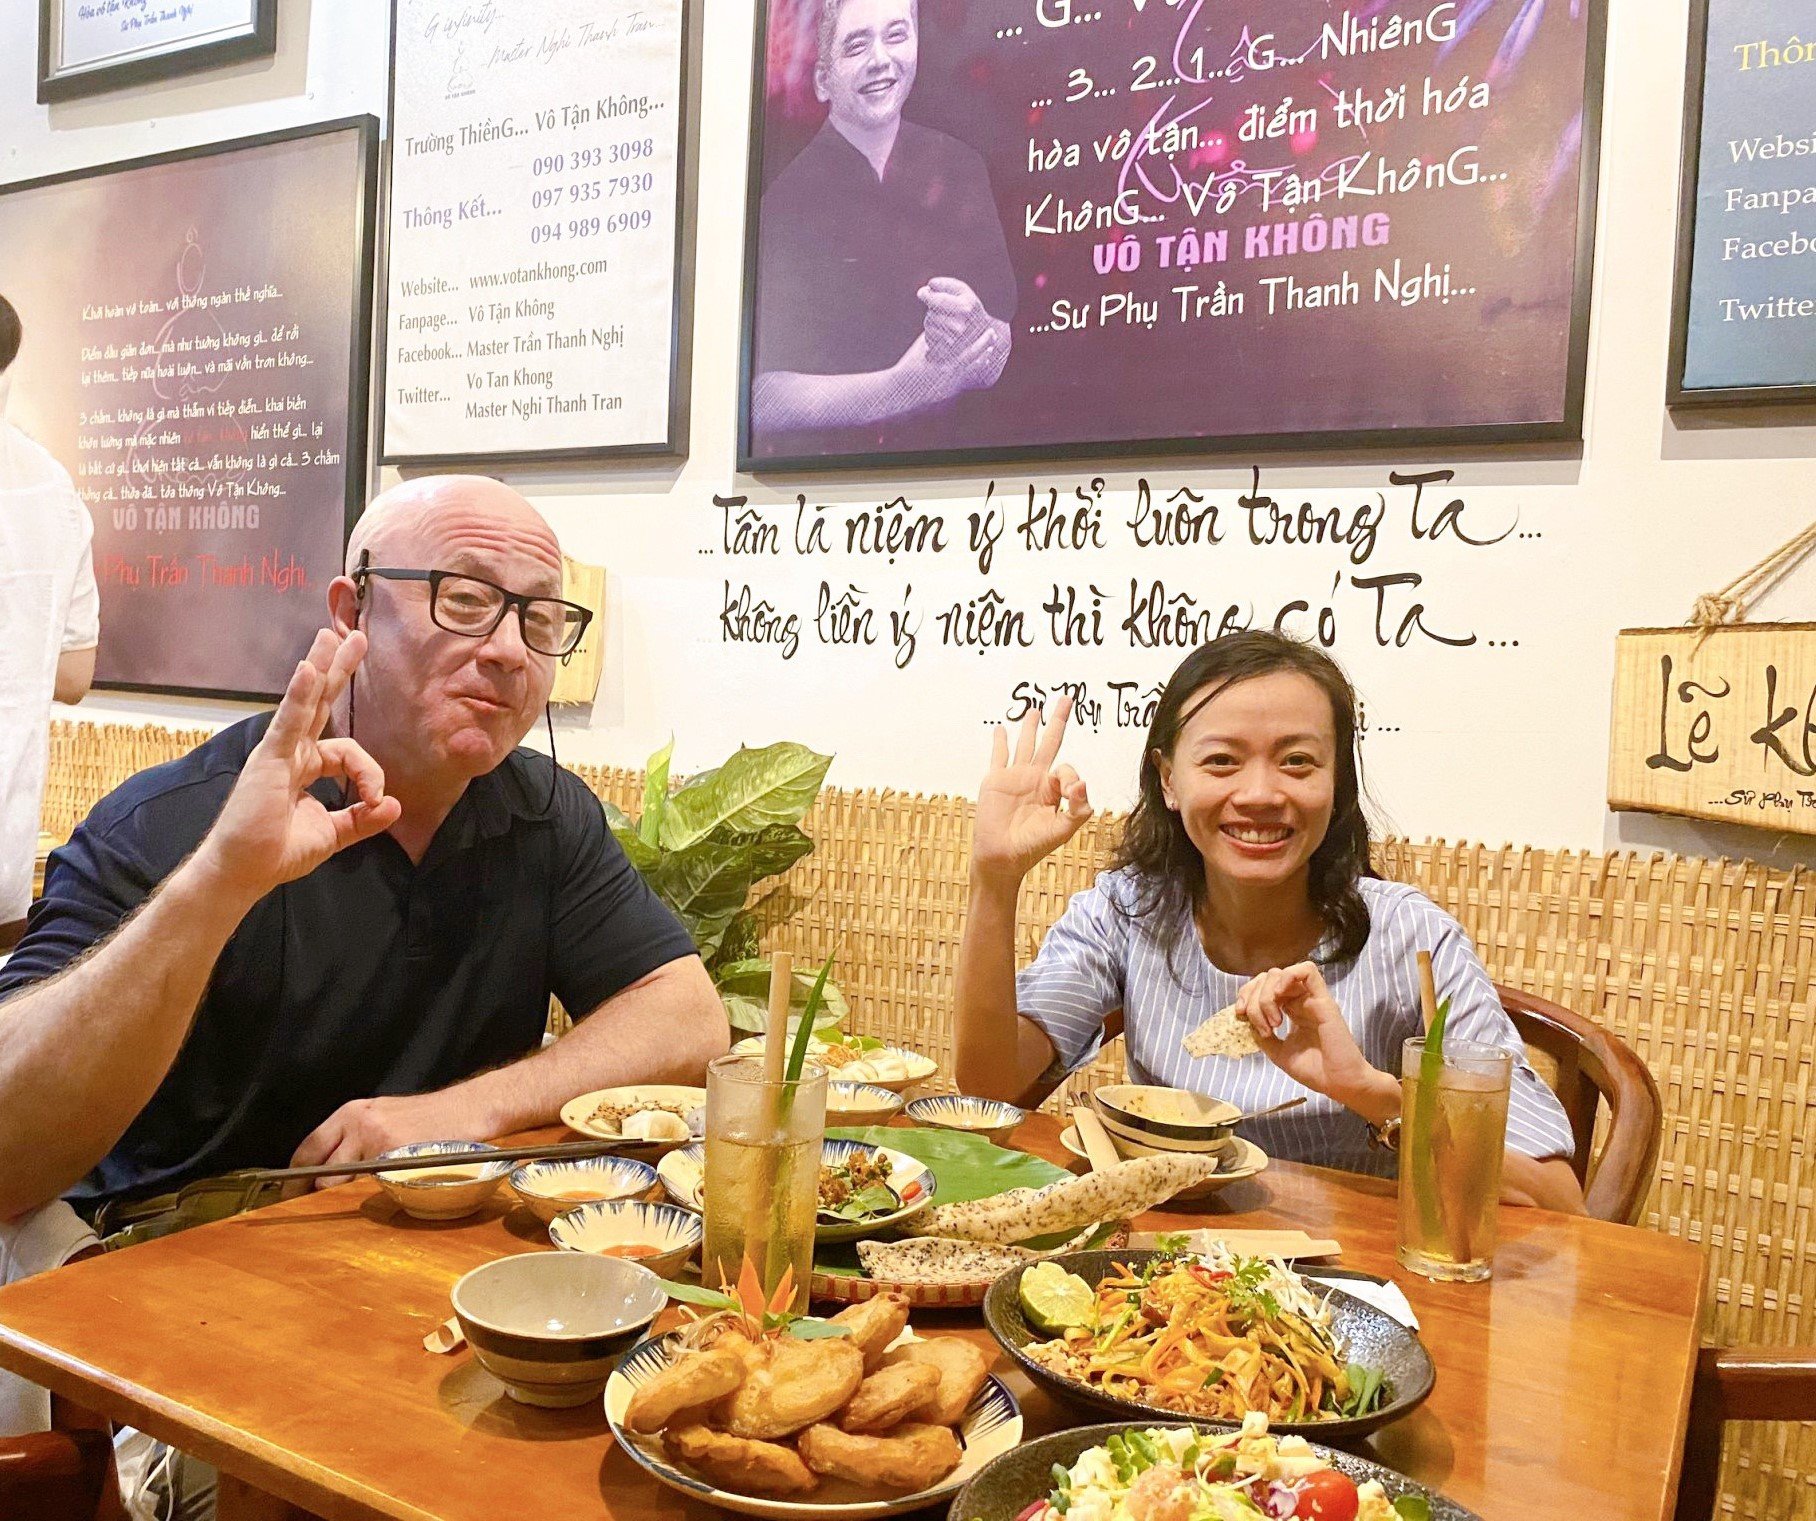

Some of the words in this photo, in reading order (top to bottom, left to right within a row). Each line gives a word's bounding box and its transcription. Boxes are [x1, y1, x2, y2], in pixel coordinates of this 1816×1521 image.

[1066, 68, 1116, 102] 3...
[1130, 55, 1181, 91] 2...
[1321, 2, 1457, 59] NhiênG
[405, 132, 455, 156] Trường
[535, 109, 556, 132] Vô
[561, 104, 590, 131] Tận
[596, 94, 665, 121] Không...
[1028, 138, 1080, 173] hòa
[1094, 133, 1130, 162] vô
[1147, 122, 1223, 157] tận...
[1238, 97, 1317, 142] điểm
[1333, 83, 1405, 128] thời
[1422, 75, 1490, 116] hóa
[533, 154, 564, 176] 090
[570, 148, 602, 170] 393
[609, 138, 654, 164] 3098
[532, 187, 564, 209] 097
[569, 181, 601, 204] 935
[608, 172, 653, 198] 7930
[1023, 189, 1165, 238] KhônG...
[1184, 171, 1236, 217] Vô
[1252, 171, 1321, 212] Tận
[1337, 144, 1508, 200] KhônG...
[403, 207, 453, 230] Thông
[458, 193, 502, 221] Kết...
[531, 222, 562, 244] 094
[568, 216, 601, 239] 989
[607, 209, 651, 234] 6909
[1092, 233, 1141, 275] VÔ
[1156, 228, 1227, 270] TẬN
[1244, 211, 1390, 259] KHÔNG
[400, 276, 459, 298] Website...
[469, 259, 607, 289] www.votankhong.com
[1029, 298, 1089, 334] ...Sư
[1098, 293, 1158, 330] Phụ
[1173, 279, 1244, 323] Trần
[1260, 270, 1359, 315] Thanh
[1374, 258, 1476, 307] Nghị...
[399, 312, 458, 334] Fanpage...
[468, 304, 484, 323] Vô
[488, 302, 511, 325] Tận
[515, 298, 555, 321] Không
[398, 342, 462, 364] Facebook...
[466, 340, 509, 358] Master
[513, 330, 542, 354] Trần
[546, 328, 587, 350] Thanh
[591, 325, 624, 352] Nghị
[398, 387, 451, 405] Twitter...
[466, 373, 483, 390] Vo
[486, 371, 509, 388] Tan
[514, 367, 553, 390] Khong
[465, 402, 507, 420] Master
[511, 396, 542, 421] Nghi
[546, 396, 587, 414] Thanh
[591, 393, 622, 411] Tran
[301, 451, 311, 466] 3
[113, 503, 137, 531] VÔ
[145, 503, 181, 535] TẬN
[188, 501, 260, 531] KHÔNG
[846, 495, 949, 565] niệm
[968, 480, 1005, 575] ý
[1017, 477, 1107, 551] khởi
[1127, 477, 1226, 547] luôn
[1238, 465, 1385, 565] trong
[719, 579, 802, 660] không
[890, 583, 924, 669] ý
[936, 589, 1036, 656] niệm
[1043, 583, 1117, 647] thì
